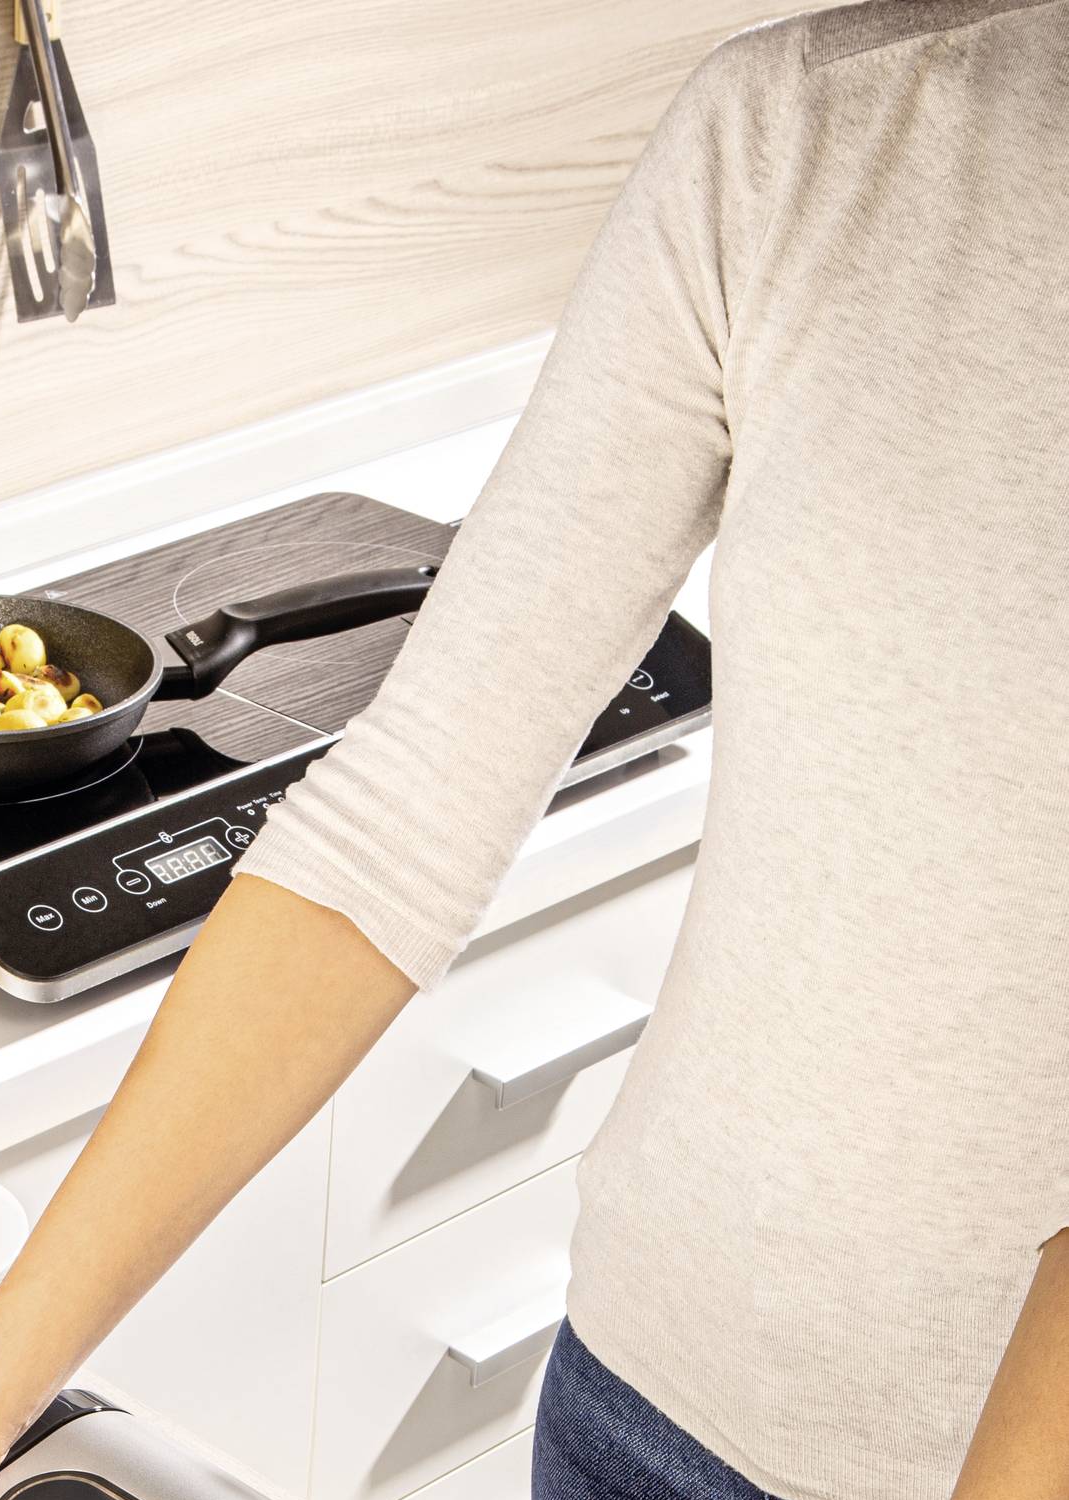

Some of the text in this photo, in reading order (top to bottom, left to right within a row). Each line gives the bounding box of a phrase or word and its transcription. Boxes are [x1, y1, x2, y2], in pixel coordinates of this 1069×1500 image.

[81, 894, 98, 905] Min
[146, 898, 167, 910] Down
[35, 911, 55, 924] Max
